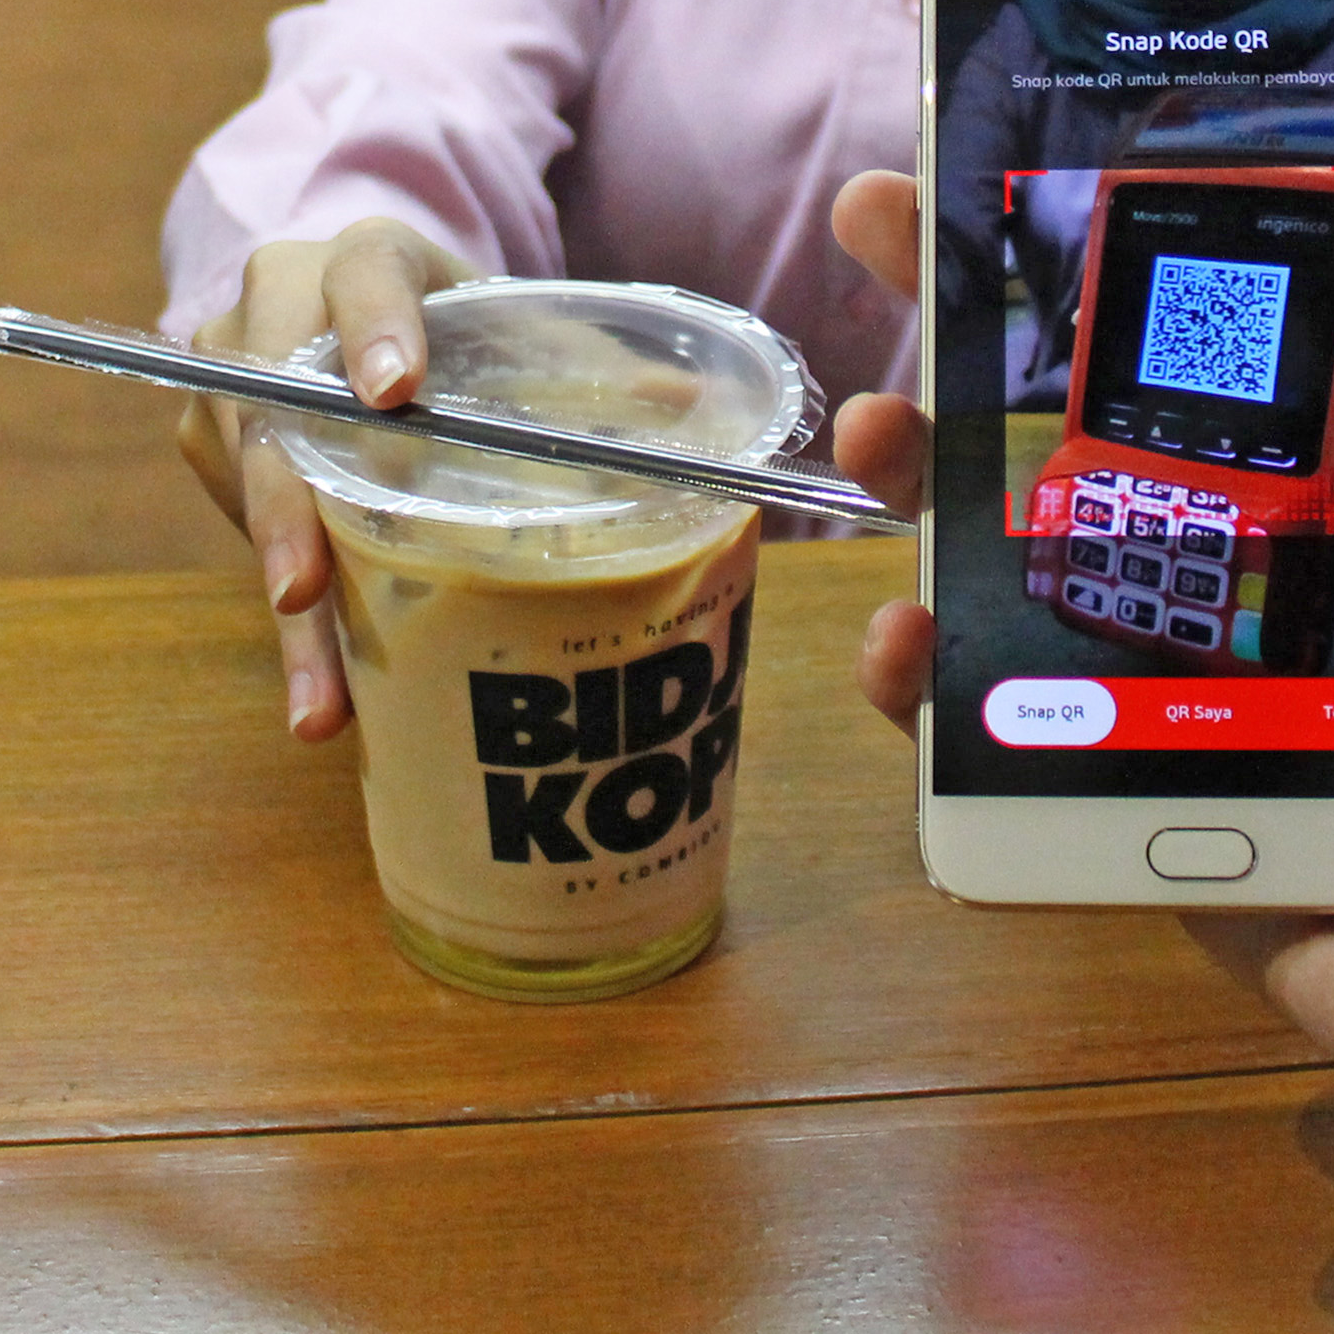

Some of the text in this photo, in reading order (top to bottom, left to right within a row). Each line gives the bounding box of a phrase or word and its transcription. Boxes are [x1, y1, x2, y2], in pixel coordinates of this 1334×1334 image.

[1105, 29, 1269, 56] Snap Kode QR
[1012, 73, 1052, 90] Snap
[1055, 71, 1095, 88] kode
[1097, 71, 1123, 89] QR
[1126, 71, 1172, 88] untuk
[1174, 70, 1261, 87] melakukan
[1017, 703, 1055, 723] Snap
[1058, 703, 1085, 722] QR
[1165, 703, 1190, 722] QR
[1194, 703, 1233, 723] Saya
[483, 704, 742, 865] KOP
